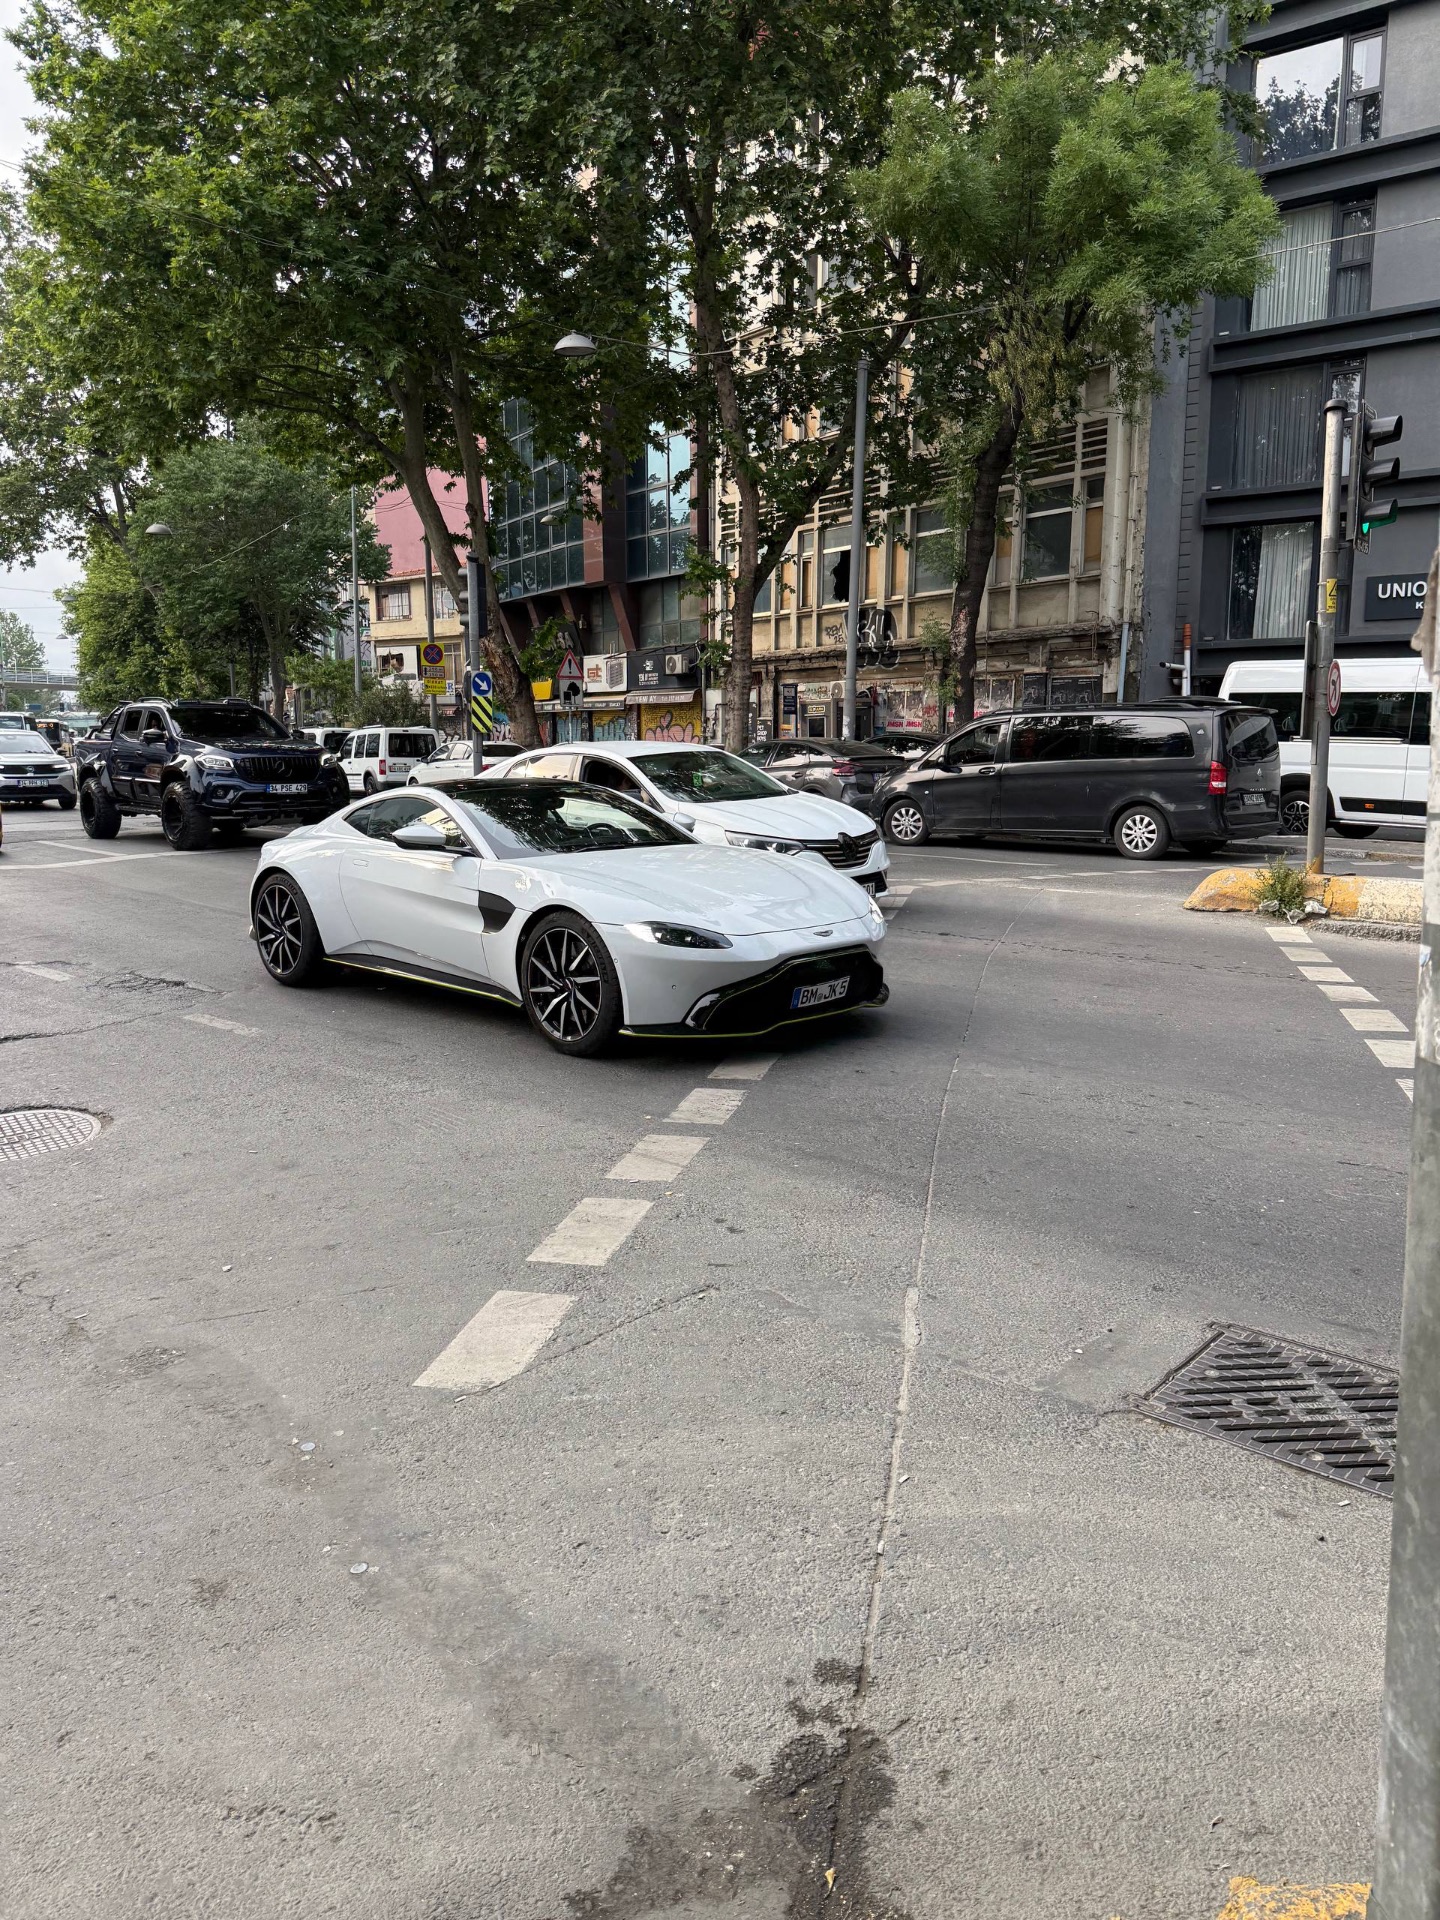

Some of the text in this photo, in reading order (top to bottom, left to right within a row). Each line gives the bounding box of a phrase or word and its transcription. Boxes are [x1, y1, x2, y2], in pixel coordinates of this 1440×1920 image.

[1377, 581, 1428, 599] UNIO
[1415, 601, 1424, 609] K
[270, 784, 307, 792] 34 PSE 429
[800, 980, 848, 1004] BM JK 5
